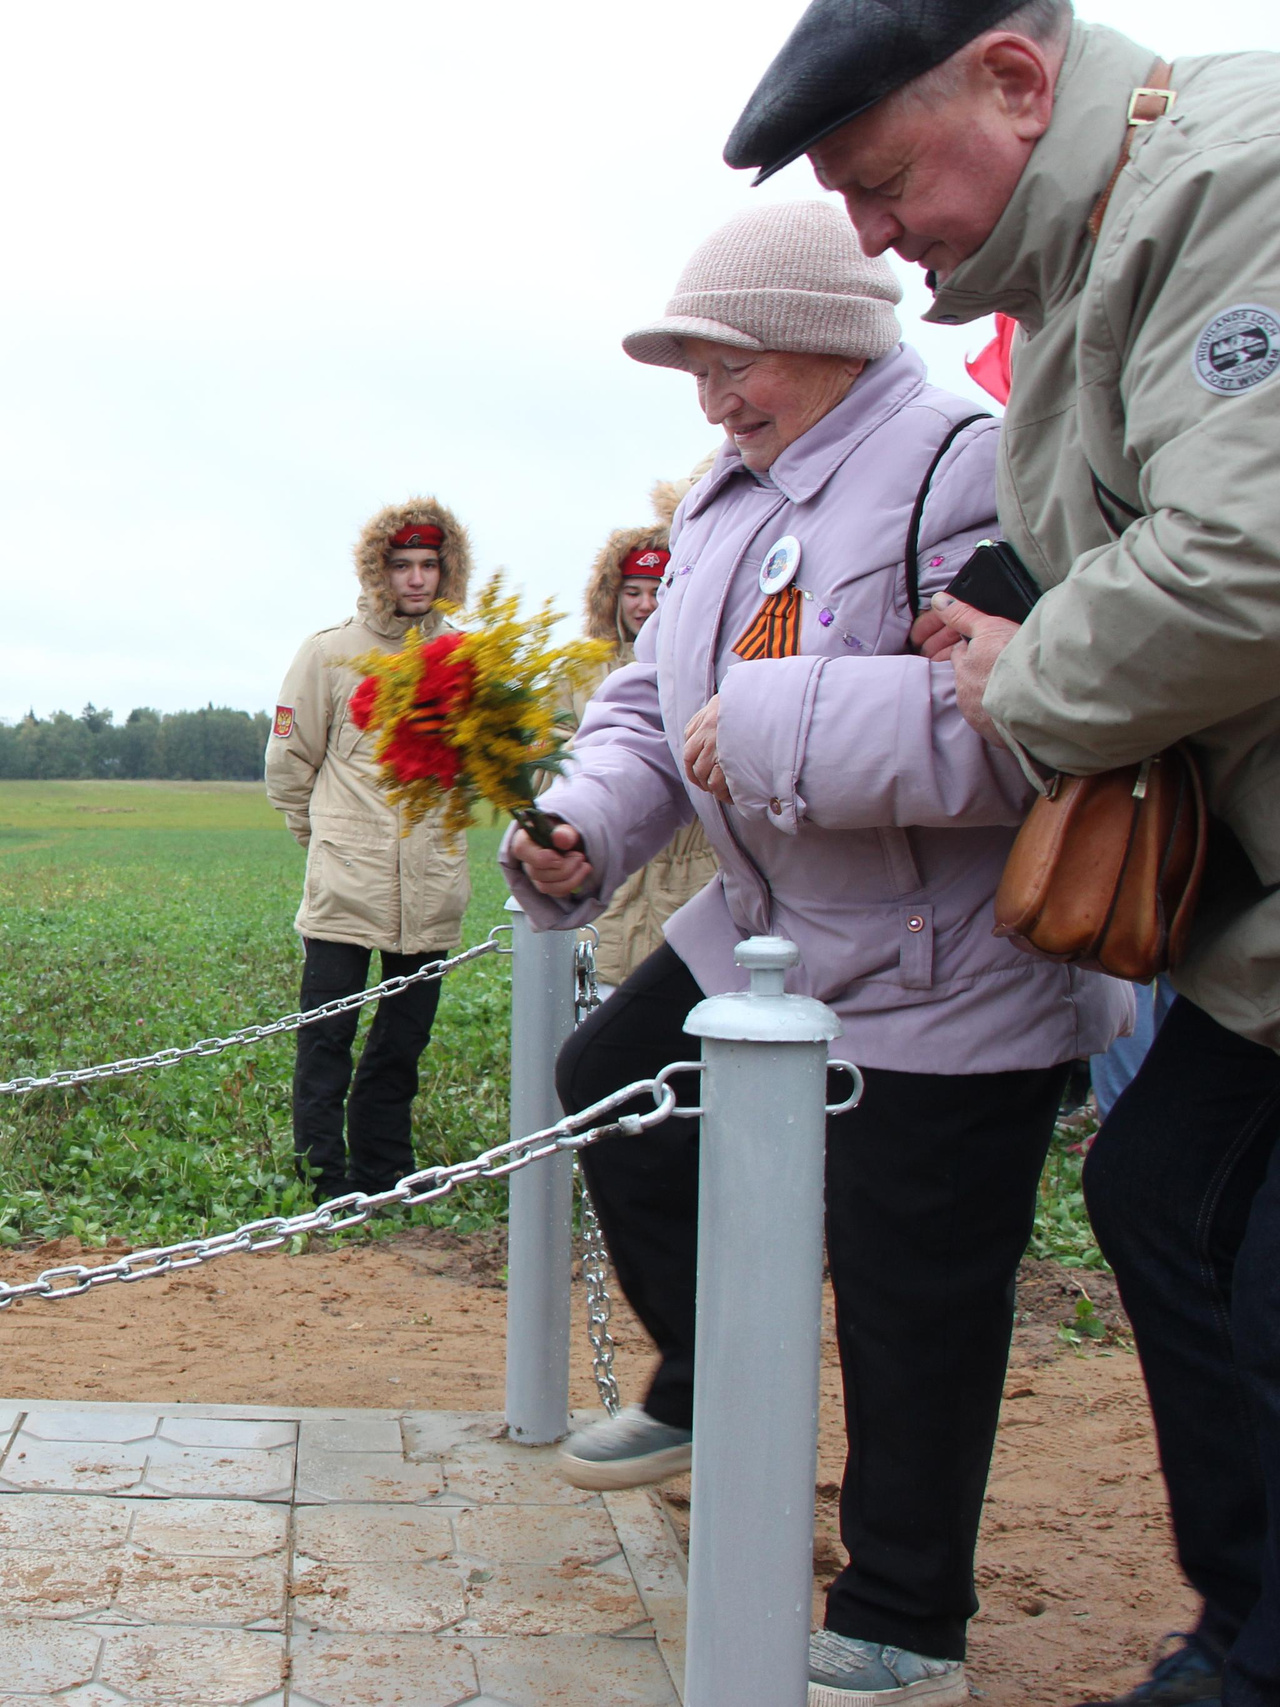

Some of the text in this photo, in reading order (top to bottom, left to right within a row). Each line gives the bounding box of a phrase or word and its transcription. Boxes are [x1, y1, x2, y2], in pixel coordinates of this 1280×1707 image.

[1198, 312, 1278, 362] HIGHLANDS LOCH
[1206, 370, 1234, 388] FORT
[1238, 348, 1280, 388] WILLIAM
